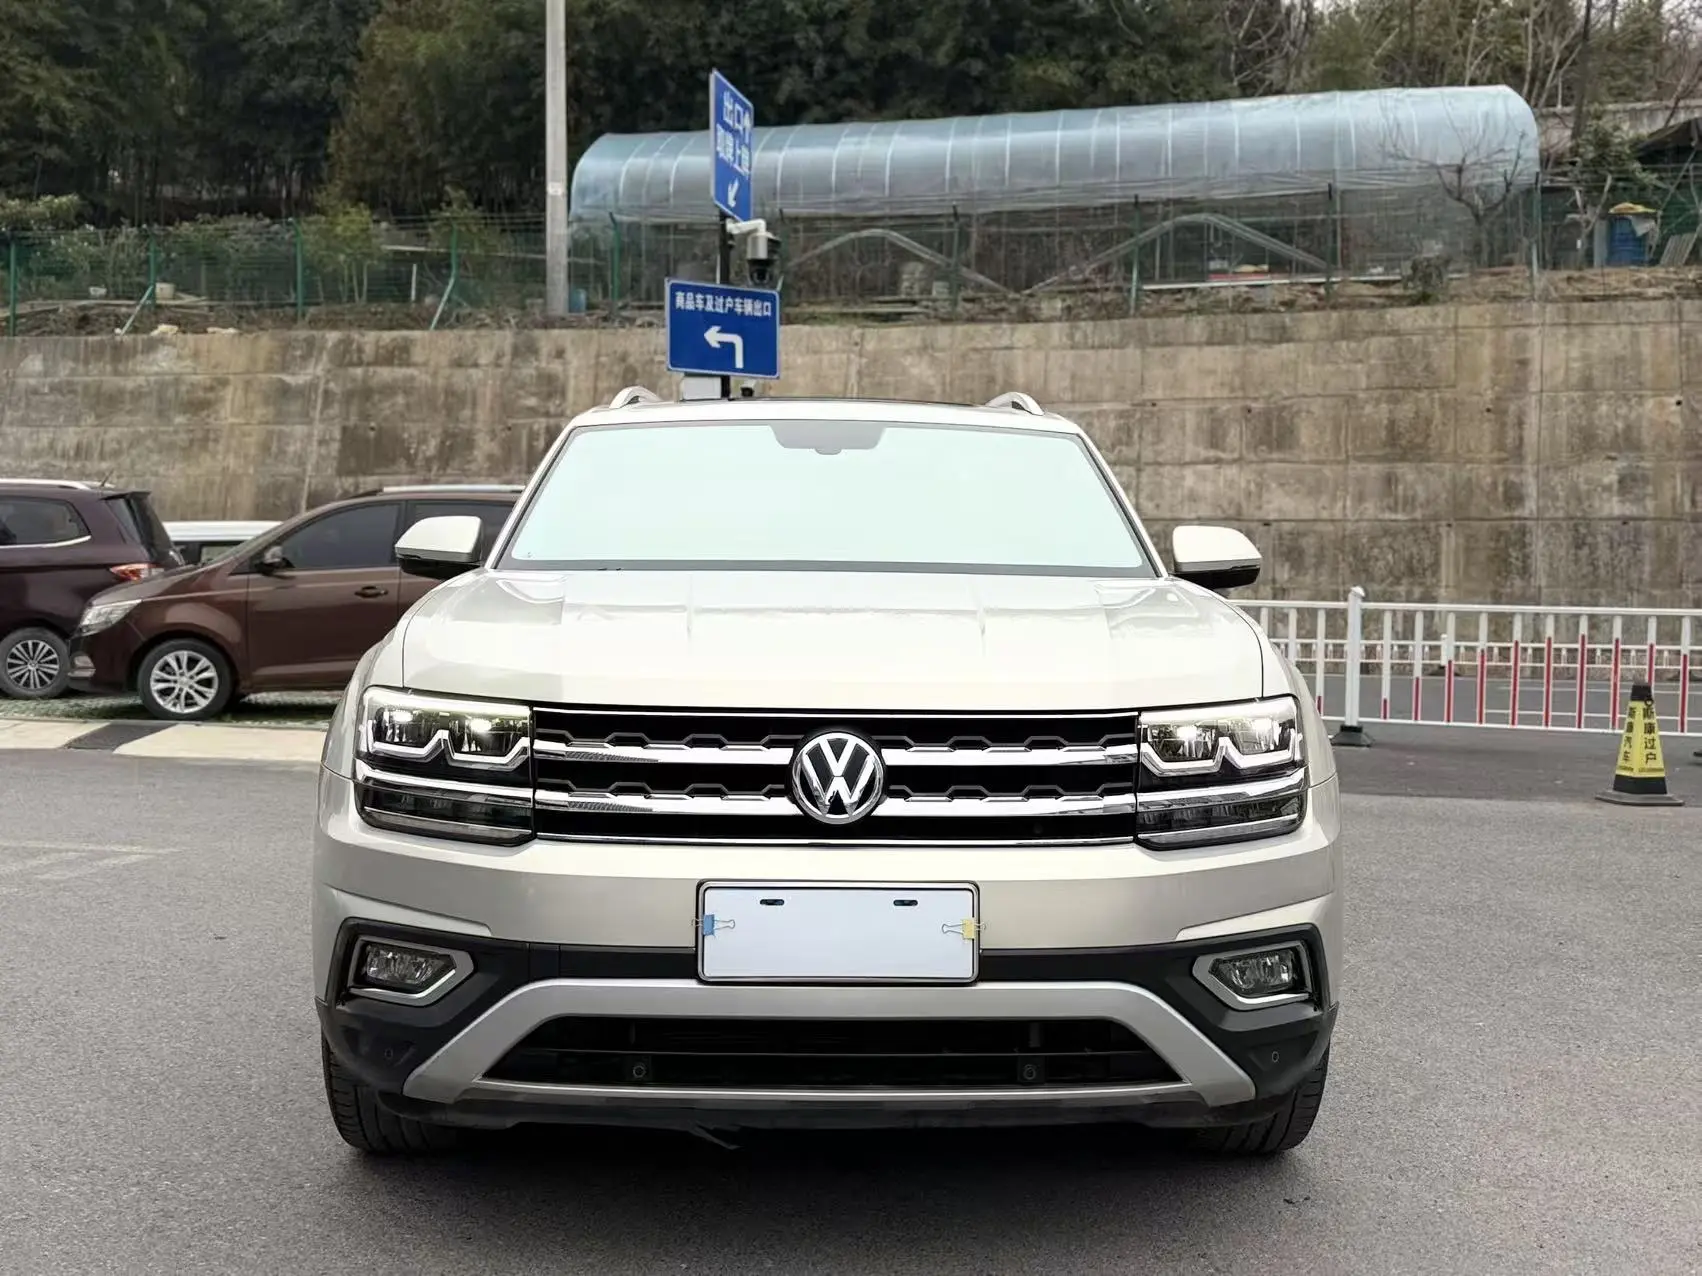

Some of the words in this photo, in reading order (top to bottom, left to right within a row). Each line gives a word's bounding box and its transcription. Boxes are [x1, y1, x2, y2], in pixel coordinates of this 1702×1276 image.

[723, 91, 744, 133] 出口
[675, 291, 772, 317] 商品车及过户车辆出口
[792, 732, 884, 824] VW
